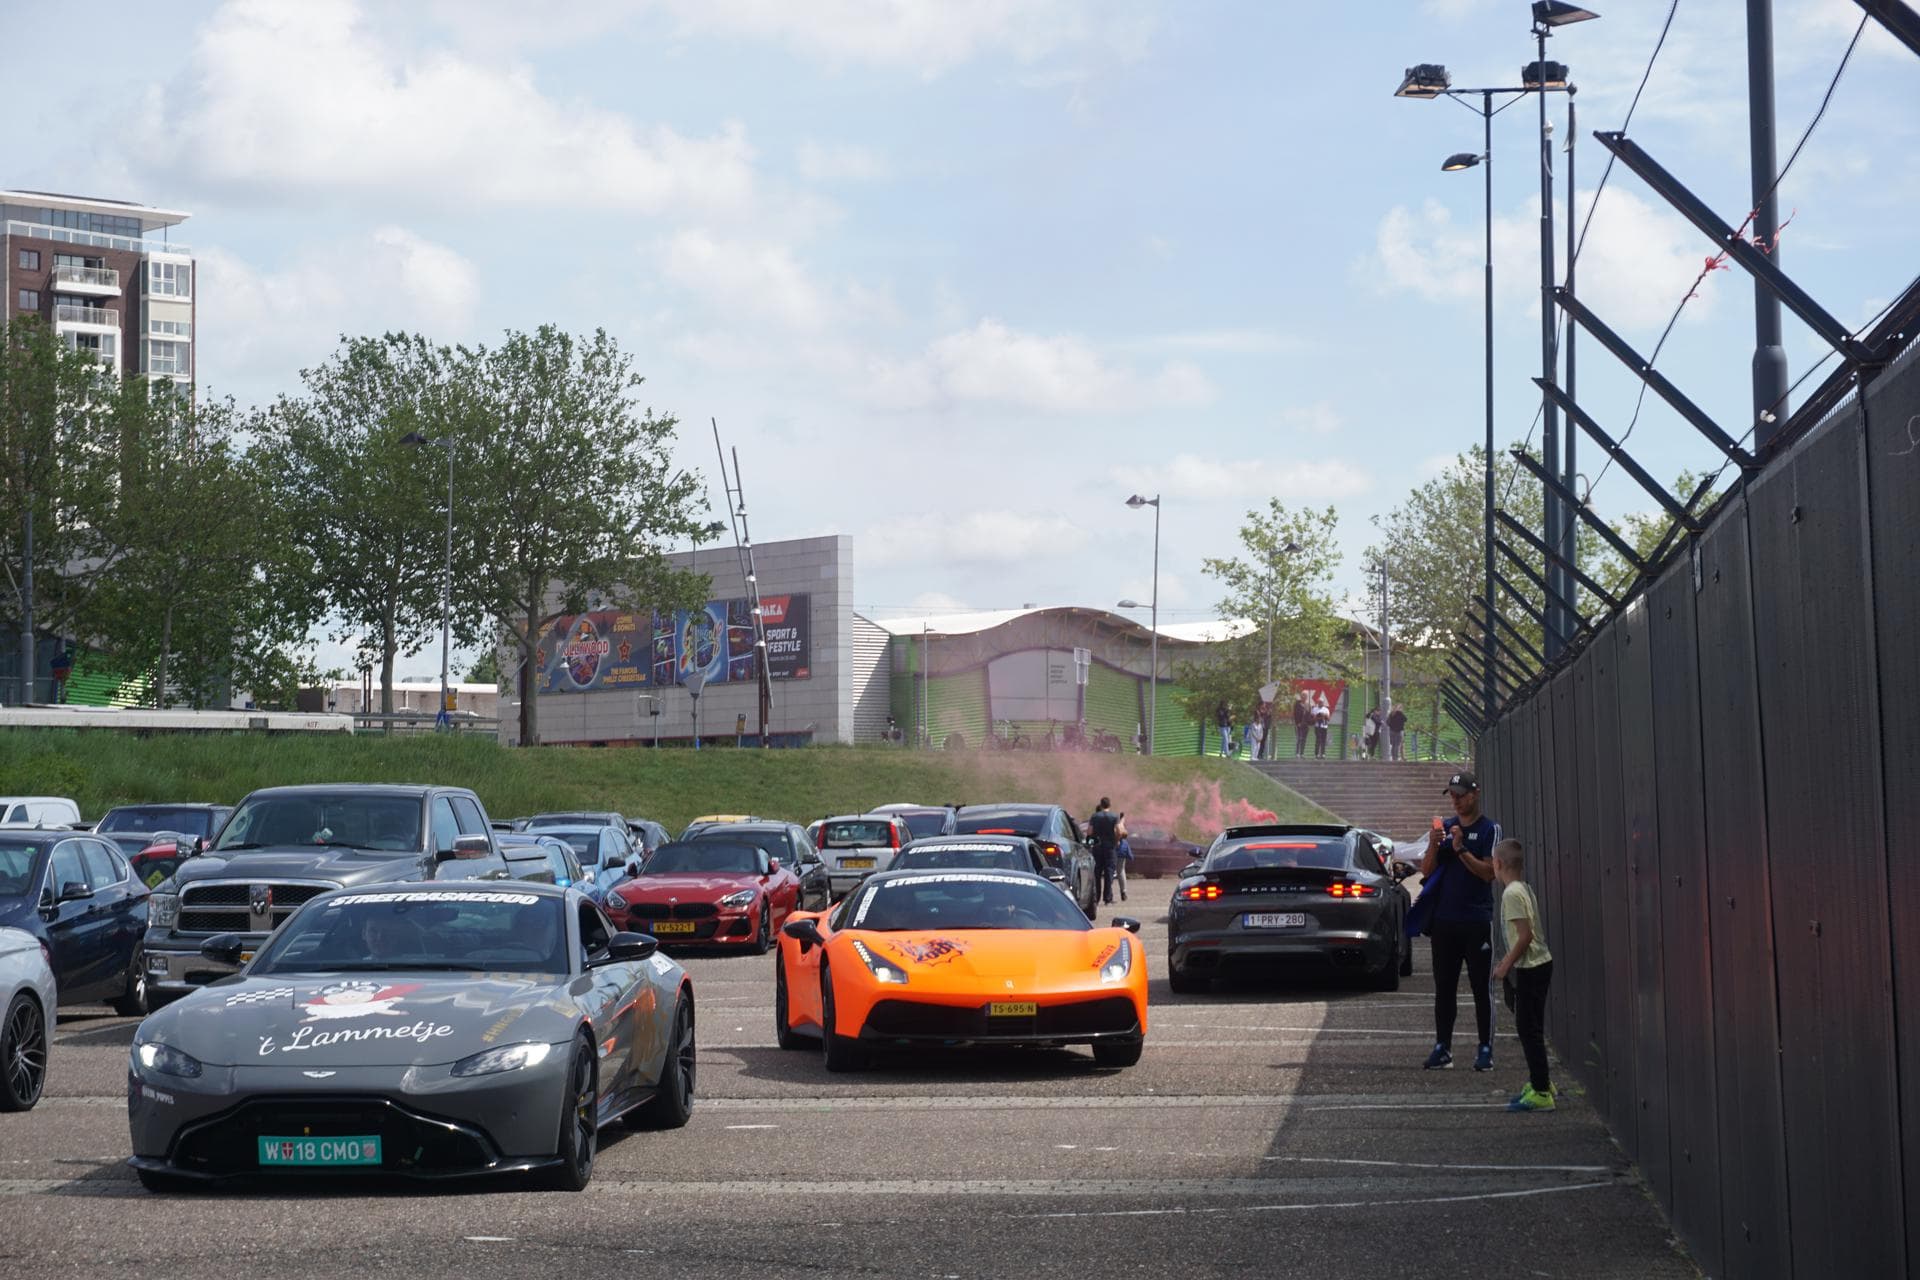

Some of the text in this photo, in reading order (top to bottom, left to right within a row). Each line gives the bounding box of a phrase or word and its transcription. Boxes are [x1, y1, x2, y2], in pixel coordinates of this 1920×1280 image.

[767, 629, 790, 640] SPORT
[768, 641, 801, 653] IFESTYLE
[282, 1020, 454, 1051] Lammetje
